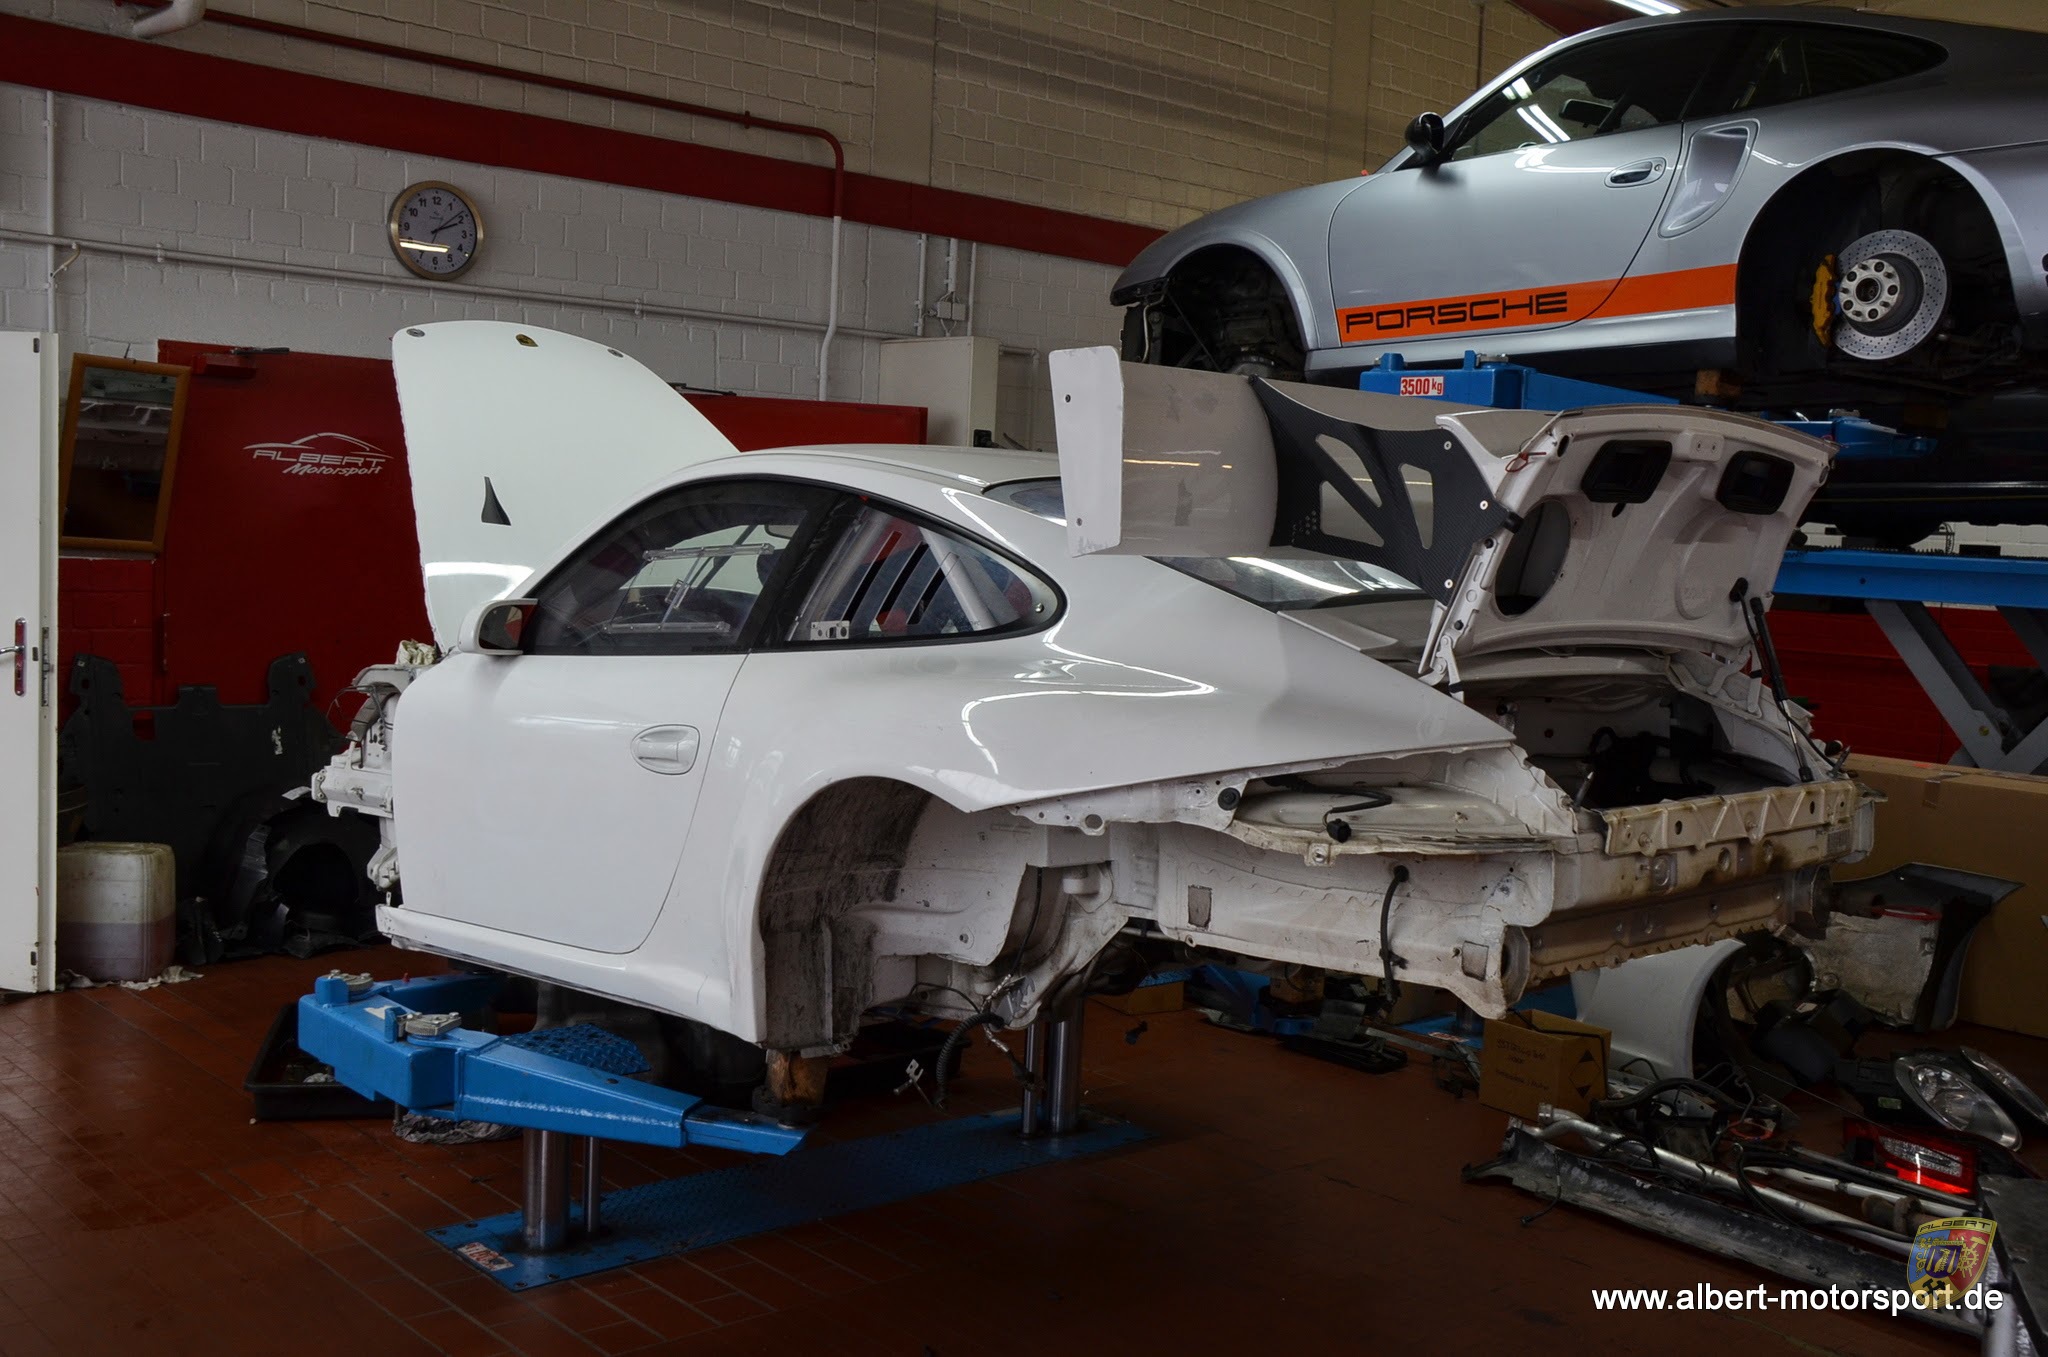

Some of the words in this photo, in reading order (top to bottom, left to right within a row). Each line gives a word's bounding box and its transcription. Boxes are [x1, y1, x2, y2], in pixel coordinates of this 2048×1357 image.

[419, 198, 427, 208] 11
[432, 196, 442, 206] 12
[448, 203, 453, 211] 1
[408, 208, 418, 217] 10
[458, 215, 464, 224] 2
[403, 222, 410, 231] 9
[461, 230, 467, 239] 3
[457, 243, 463, 252] 4
[432, 256, 439, 265] 6
[447, 253, 453, 262] 5
[1345, 291, 1568, 334] PORSCHE
[1401, 378, 1430, 395] 3500
[1431, 378, 1443, 395] kg
[252, 449, 386, 467] ALBERT
[282, 463, 383, 477] Motorsport
